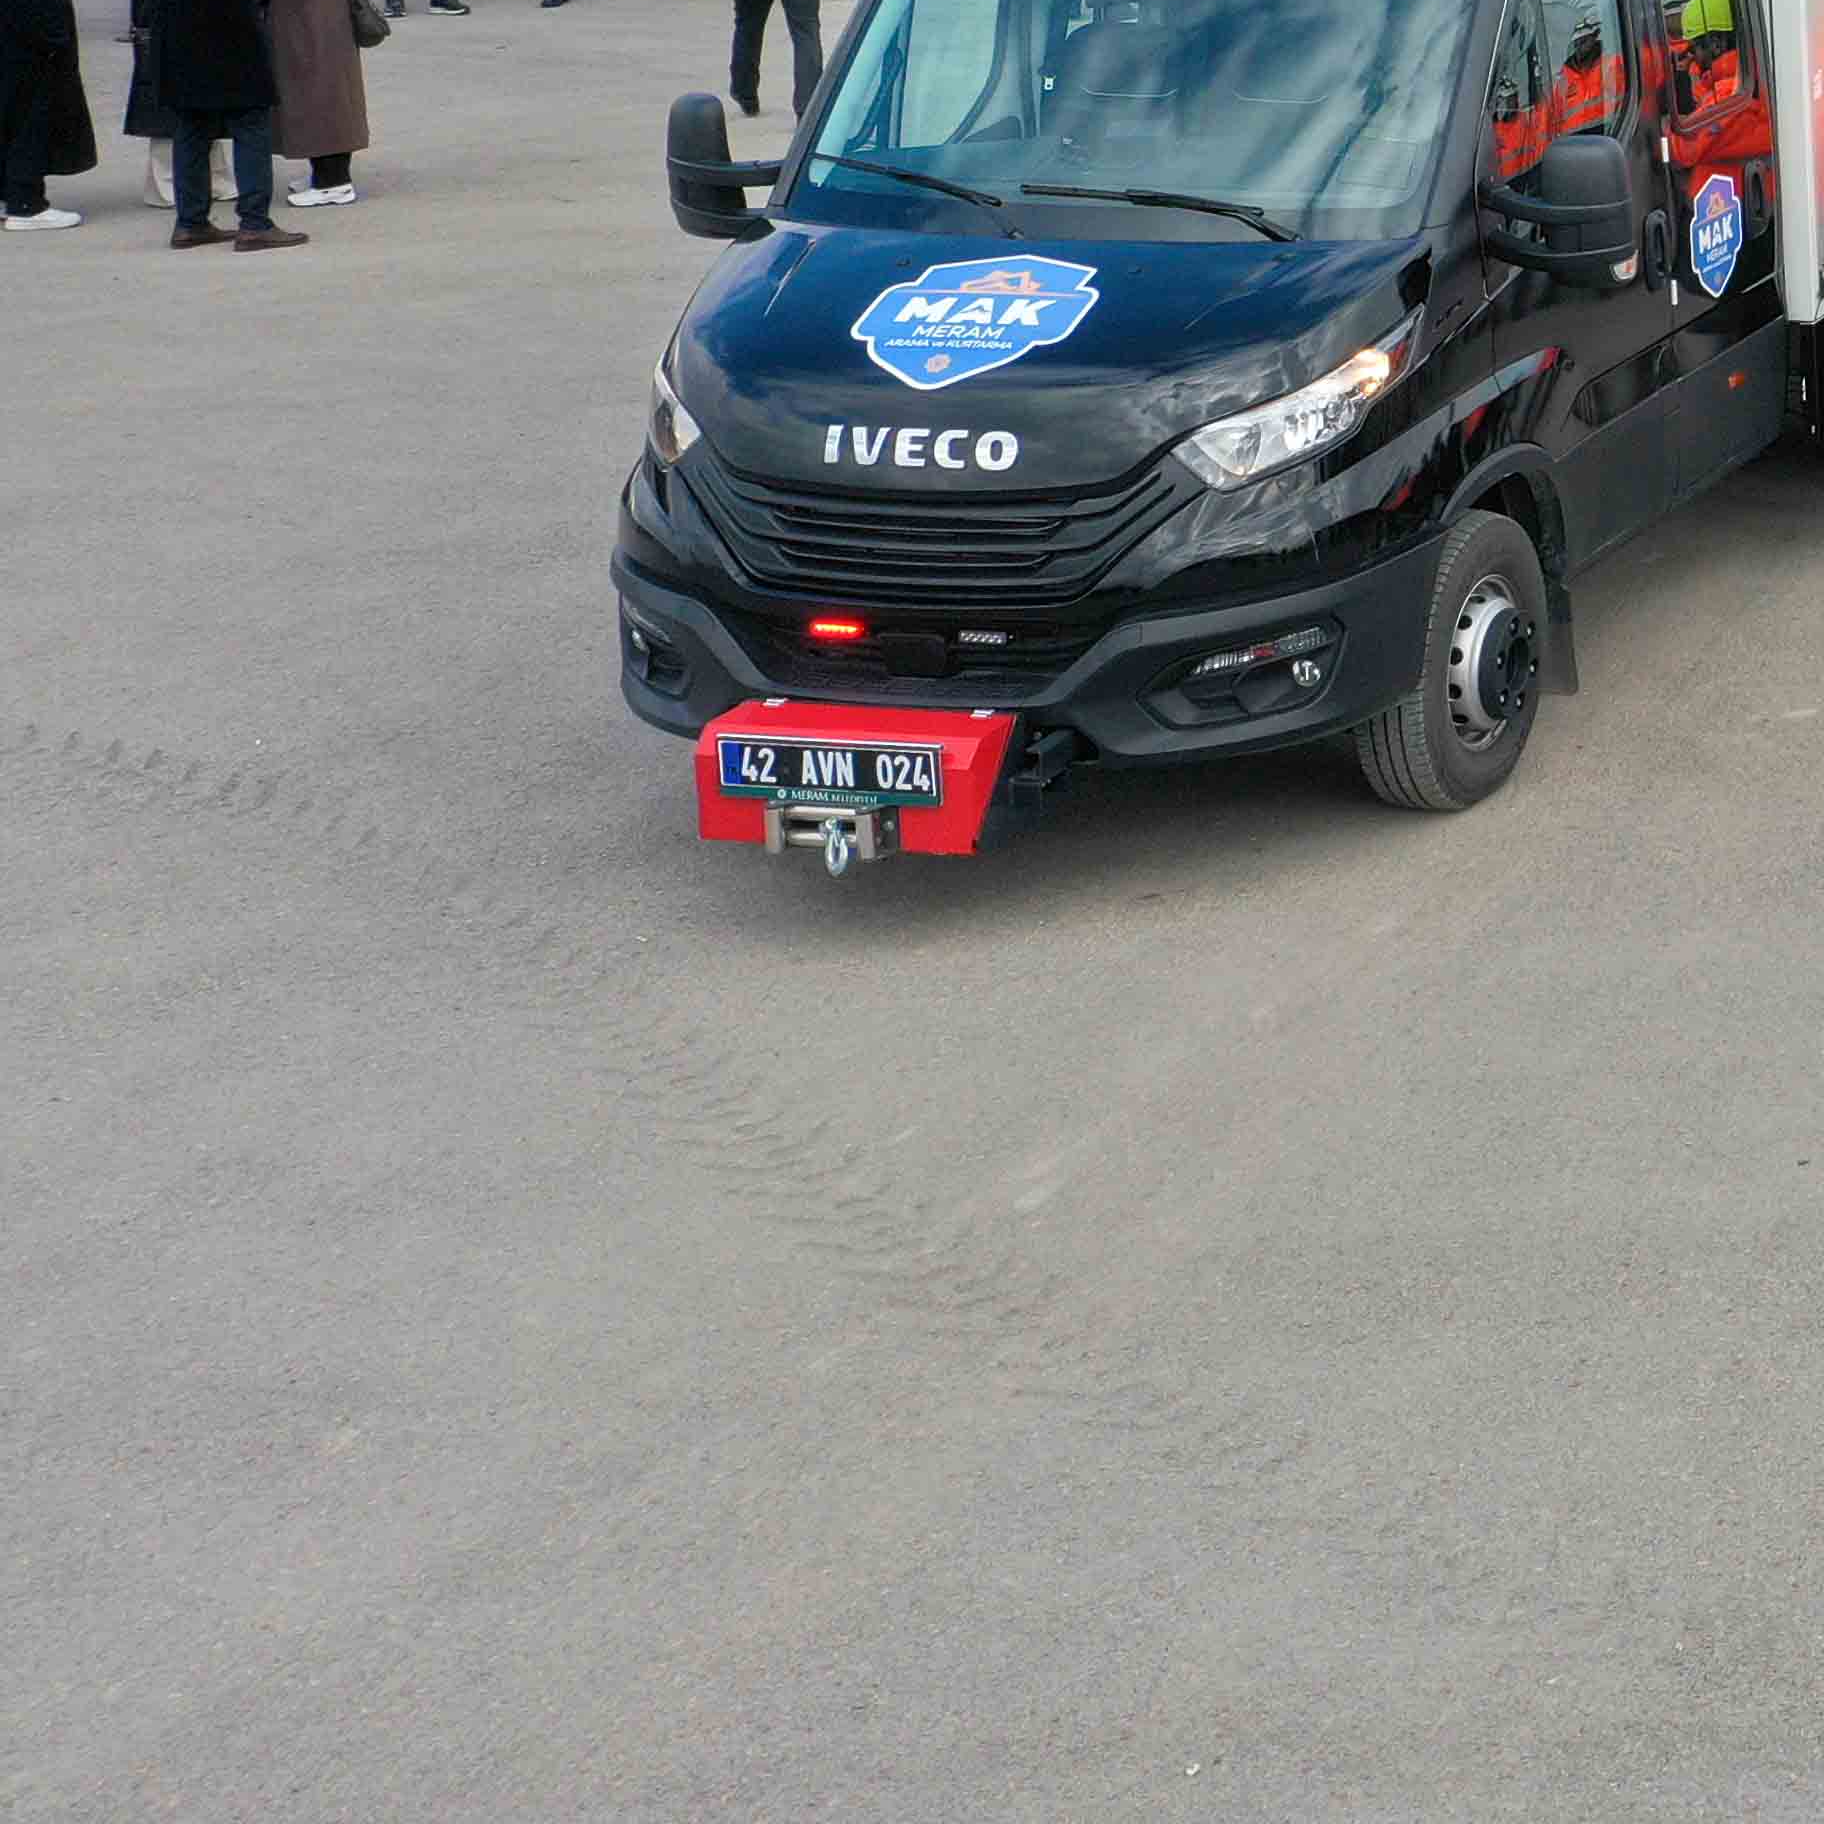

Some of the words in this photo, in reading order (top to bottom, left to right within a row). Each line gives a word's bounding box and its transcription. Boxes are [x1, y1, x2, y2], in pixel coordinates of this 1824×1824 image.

[1698, 212, 1734, 255] MAK
[892, 296, 1057, 326] MAK
[911, 324, 1005, 340] MERAM
[823, 423, 1019, 472] IVECO
[741, 745, 778, 784] 42
[801, 749, 855, 788] AVN
[875, 753, 931, 792] 024
[791, 789, 830, 803] MERAM
